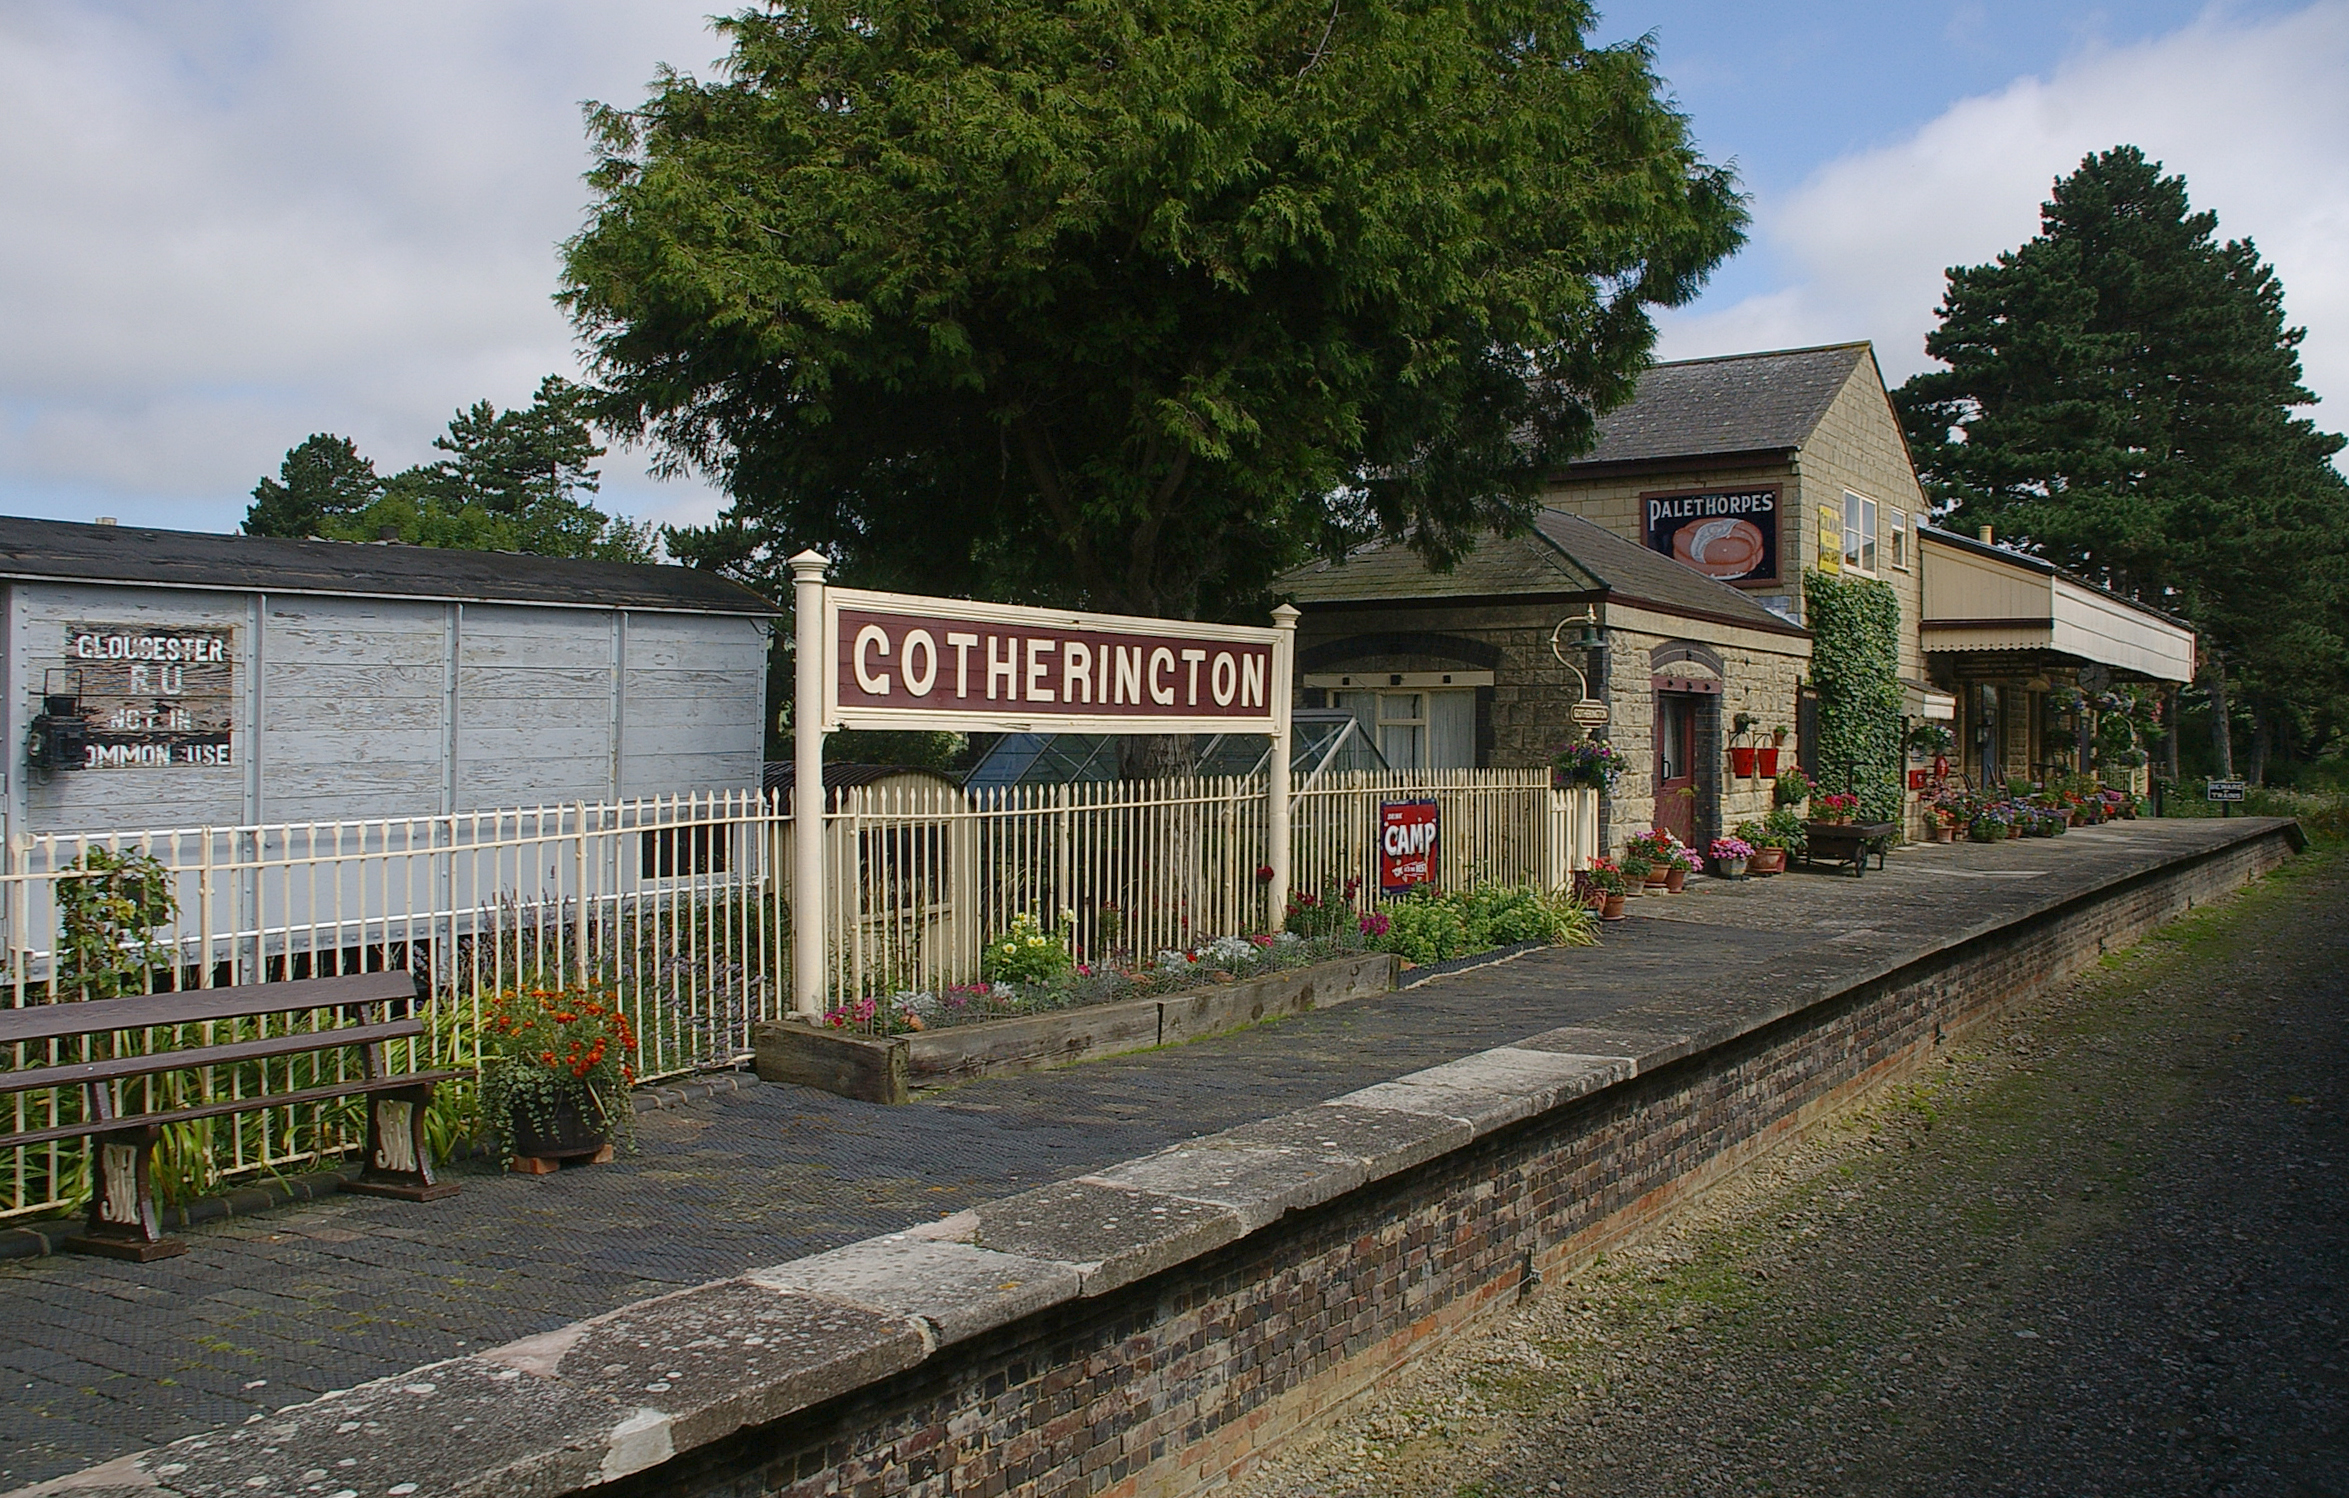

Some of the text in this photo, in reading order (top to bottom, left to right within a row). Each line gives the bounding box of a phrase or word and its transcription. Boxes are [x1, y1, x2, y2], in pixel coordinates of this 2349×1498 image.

[77, 634, 224, 661] GLOUCESTER
[852, 624, 1266, 708] GOTHERINGTON
[109, 708, 192, 730] NOT IN
[84, 743, 231, 768] OMMON USE
[1384, 822, 1436, 857] CAMP
